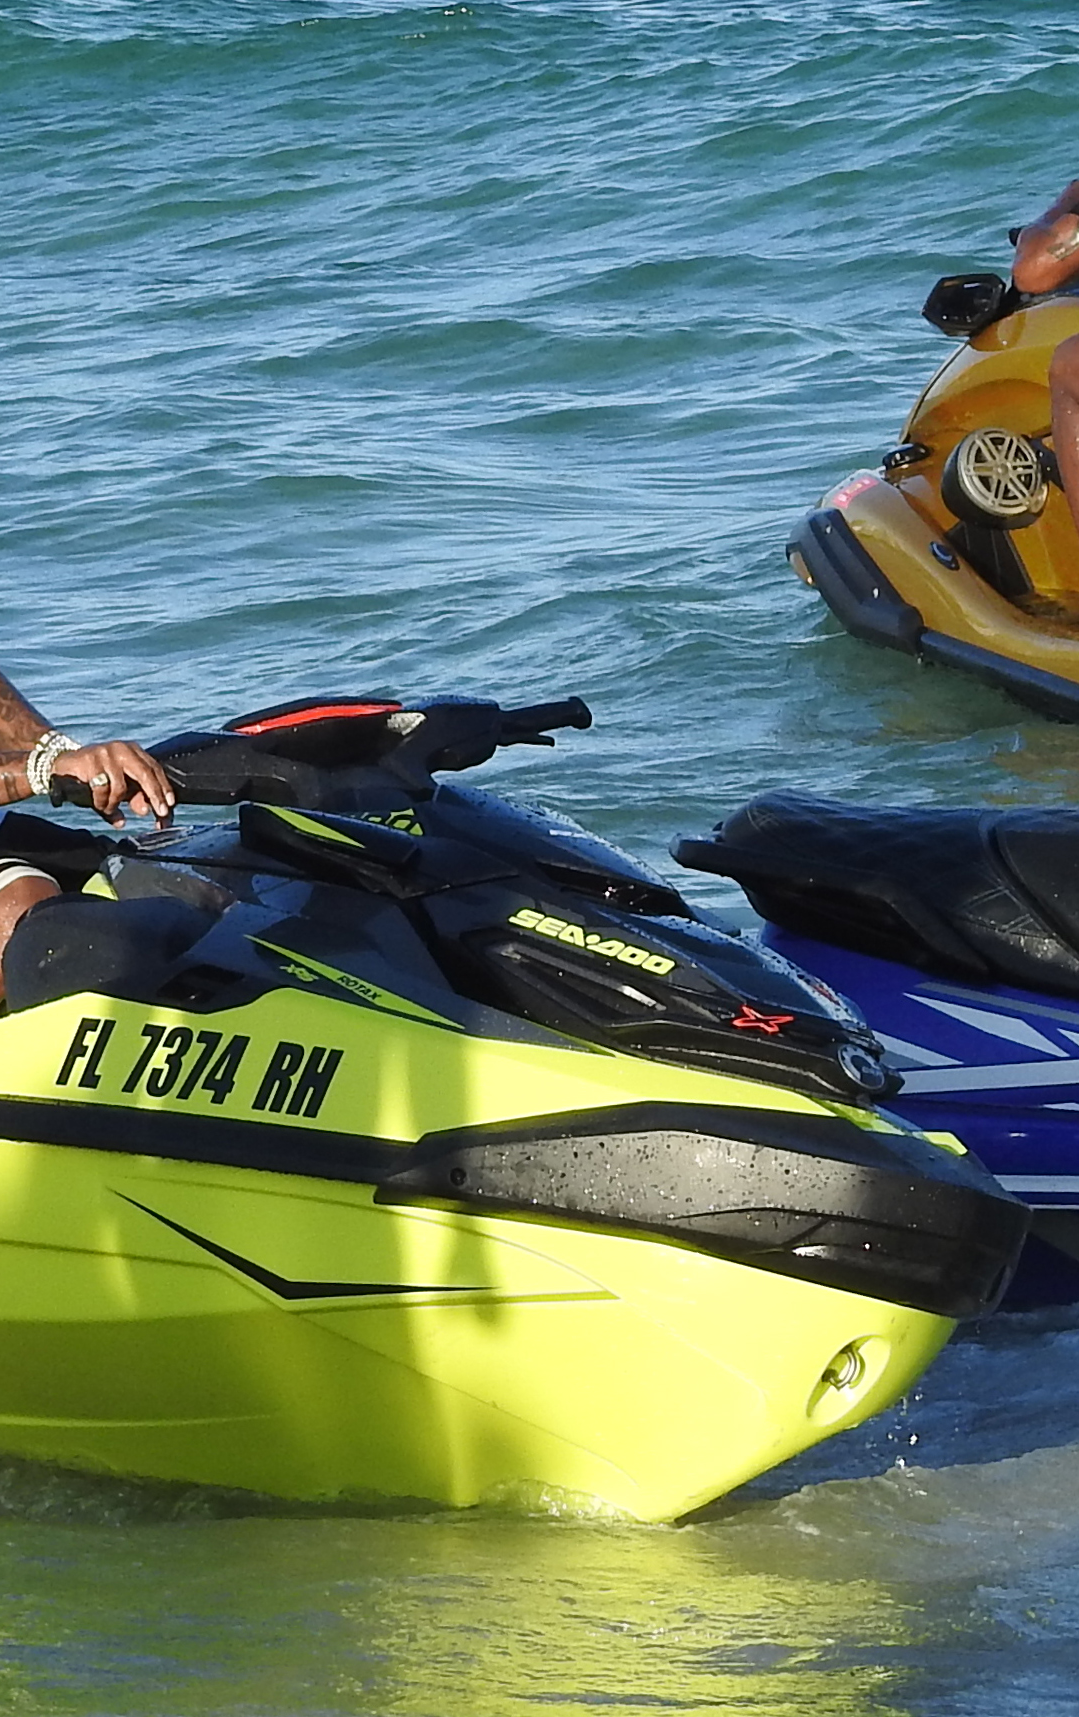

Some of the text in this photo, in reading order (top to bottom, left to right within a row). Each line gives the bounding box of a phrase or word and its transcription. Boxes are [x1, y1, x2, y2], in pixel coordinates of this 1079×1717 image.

[337, 975, 382, 1001] ROTAX
[55, 1017, 345, 1119] FL 7374 RH
